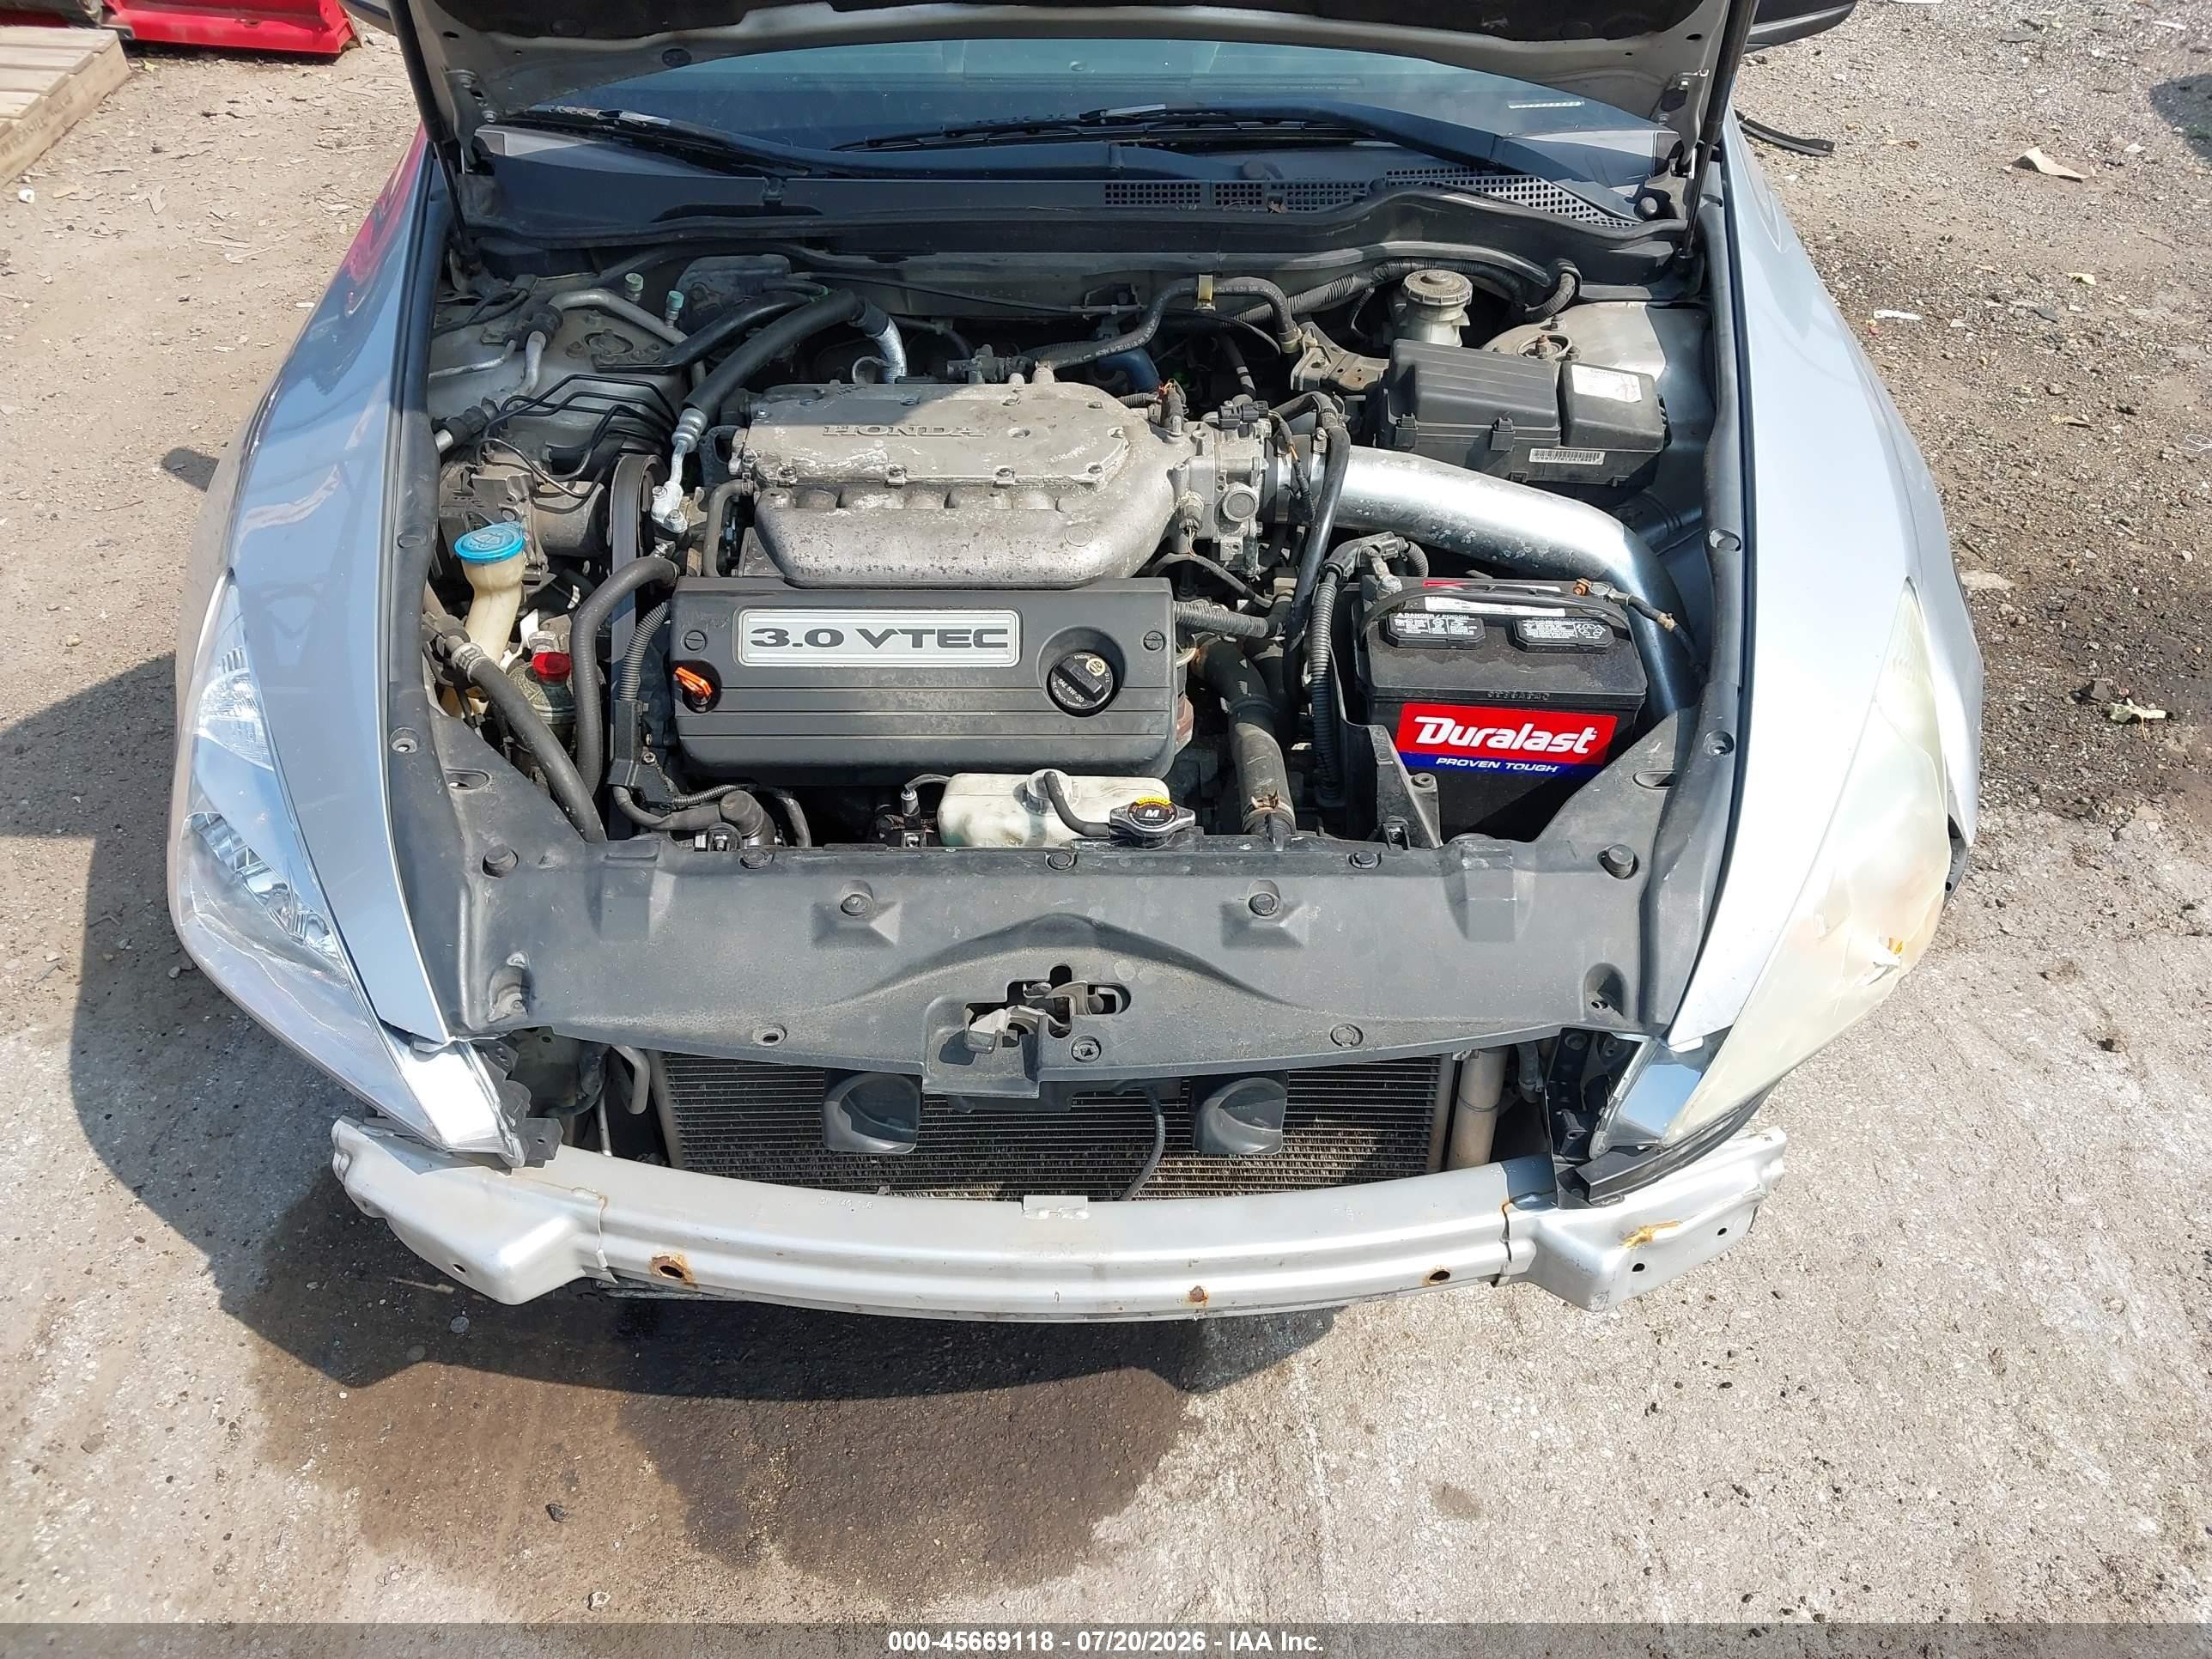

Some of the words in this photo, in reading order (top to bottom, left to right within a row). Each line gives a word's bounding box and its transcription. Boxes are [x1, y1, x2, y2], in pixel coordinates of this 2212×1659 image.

[822, 424, 987, 437] HONDA
[750, 628, 844, 648] 3.0
[854, 629, 1009, 648] VTEC
[1414, 716, 1598, 754] Duralast
[1436, 757, 1501, 769] PROVEN
[1505, 762, 1559, 773] TOUGH
[1144, 809, 1160, 817] M
